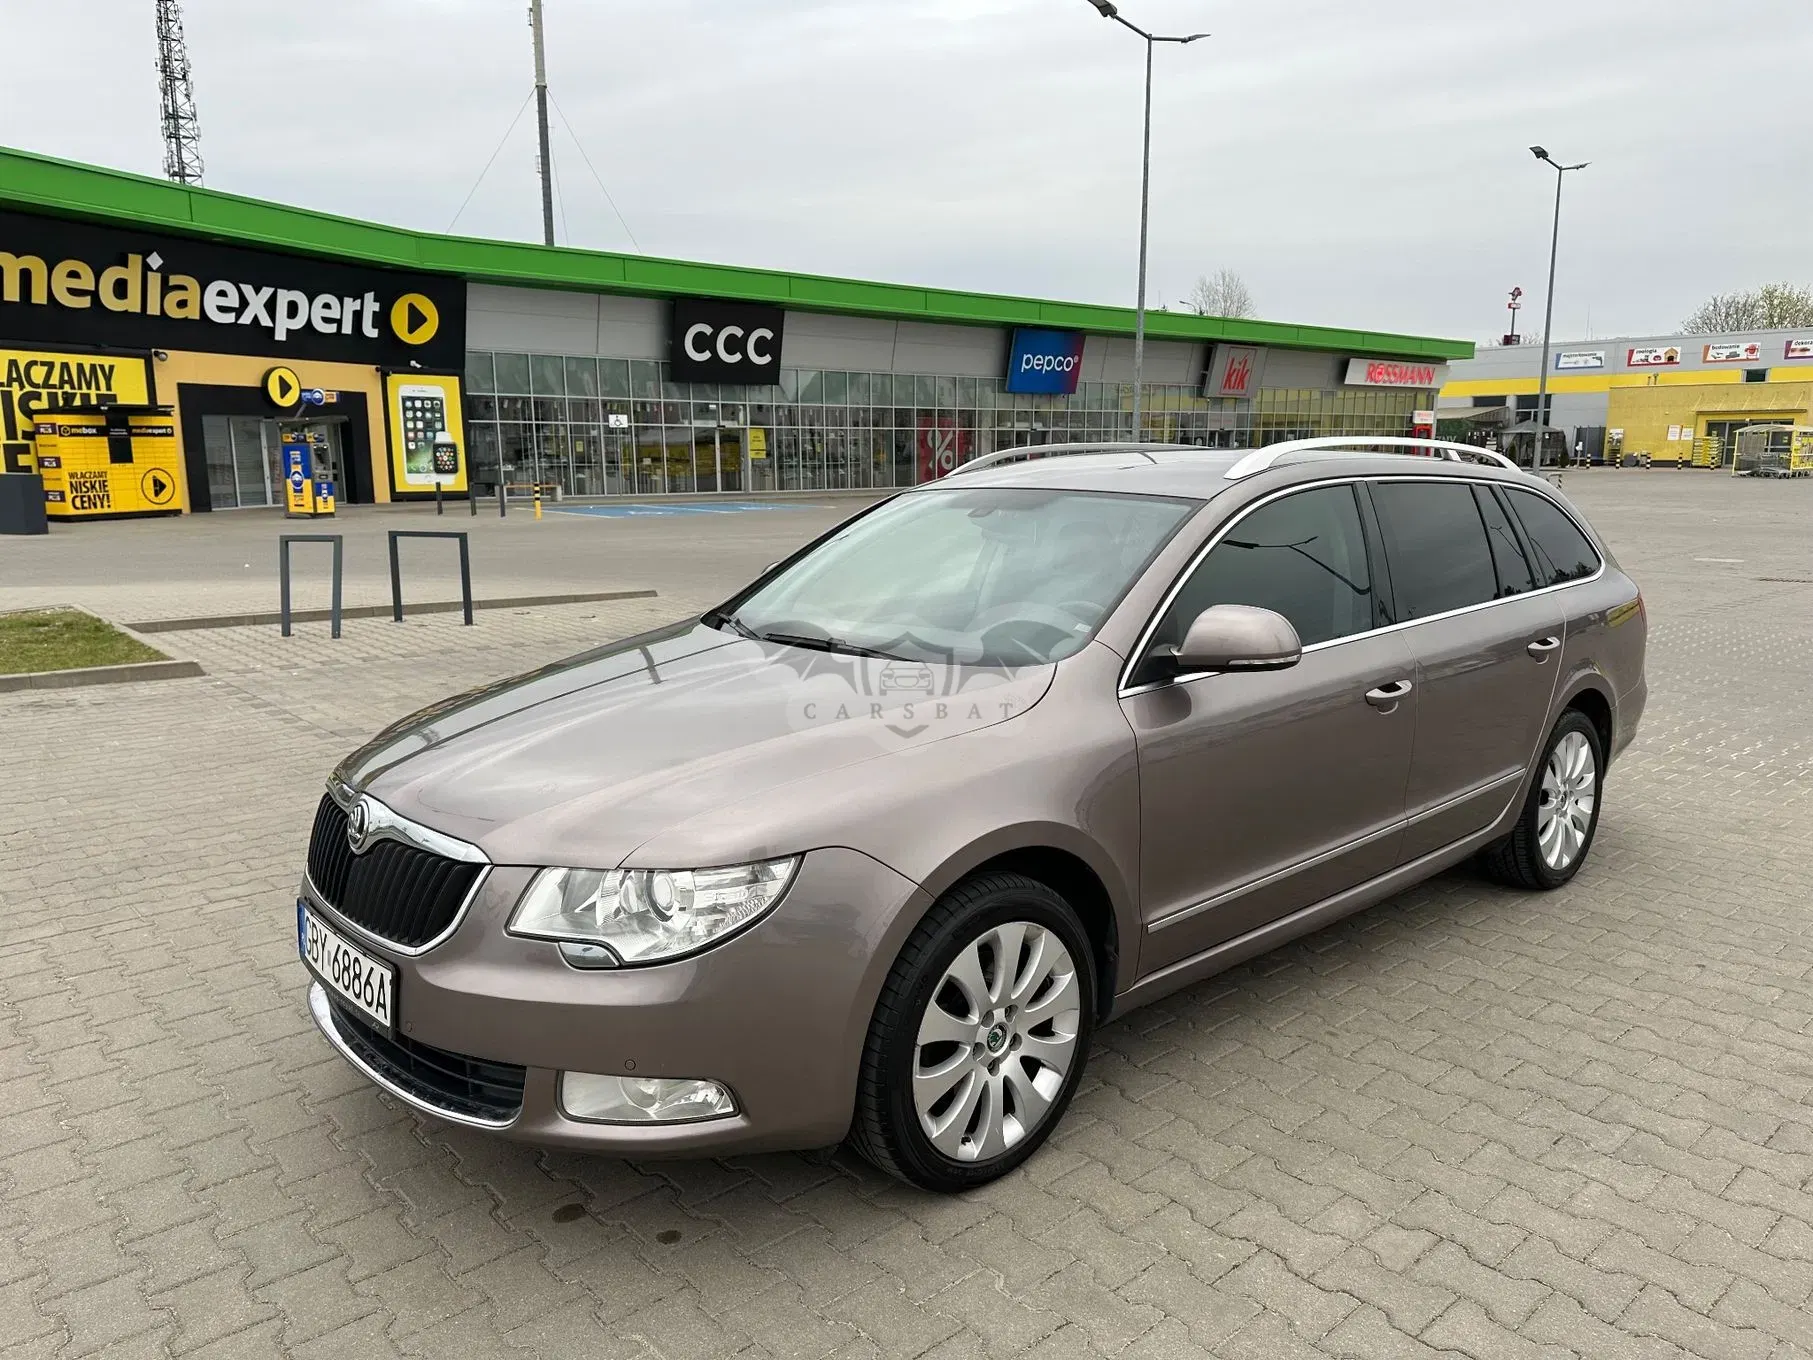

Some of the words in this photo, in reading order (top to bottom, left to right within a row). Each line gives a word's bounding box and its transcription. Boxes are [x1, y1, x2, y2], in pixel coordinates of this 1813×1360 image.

[0, 251, 380, 341] mediaexpert
[684, 323, 774, 365] CCC
[0, 359, 115, 391] ĄCZAMY
[1223, 352, 1250, 390] kik
[1365, 363, 1435, 385] ROSSMANN
[69, 479, 109, 494] NISKIE
[71, 493, 111, 511] CENY!
[305, 915, 328, 971] GBY
[332, 943, 388, 1020] 6886A
